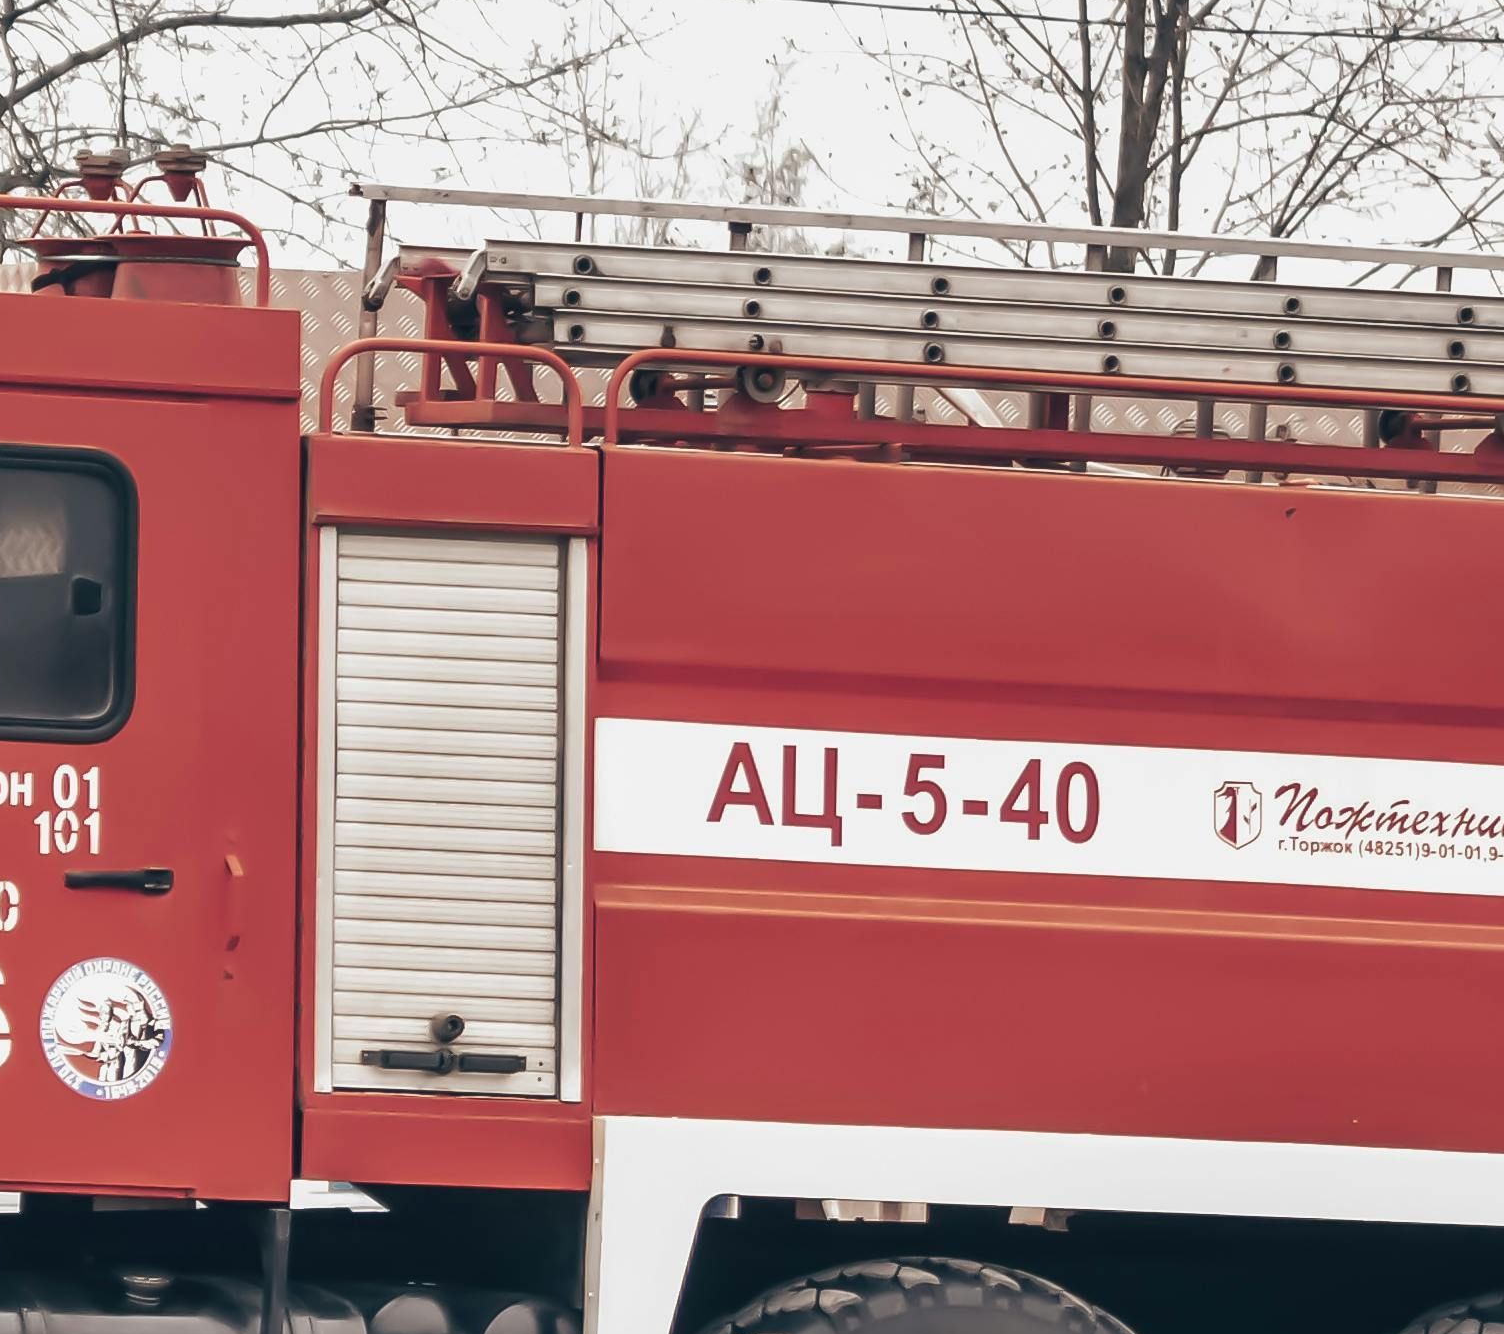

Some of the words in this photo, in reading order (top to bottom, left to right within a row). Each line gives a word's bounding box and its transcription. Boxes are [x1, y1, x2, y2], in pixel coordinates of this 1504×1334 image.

[53, 763, 100, 810] 01
[706, 741, 1100, 847] АЦ-5-40
[33, 810, 101, 855] 101
[41, 965, 84, 1039] ПОЖАРНОЙ
[82, 959, 142, 981] ОХРАНЕ
